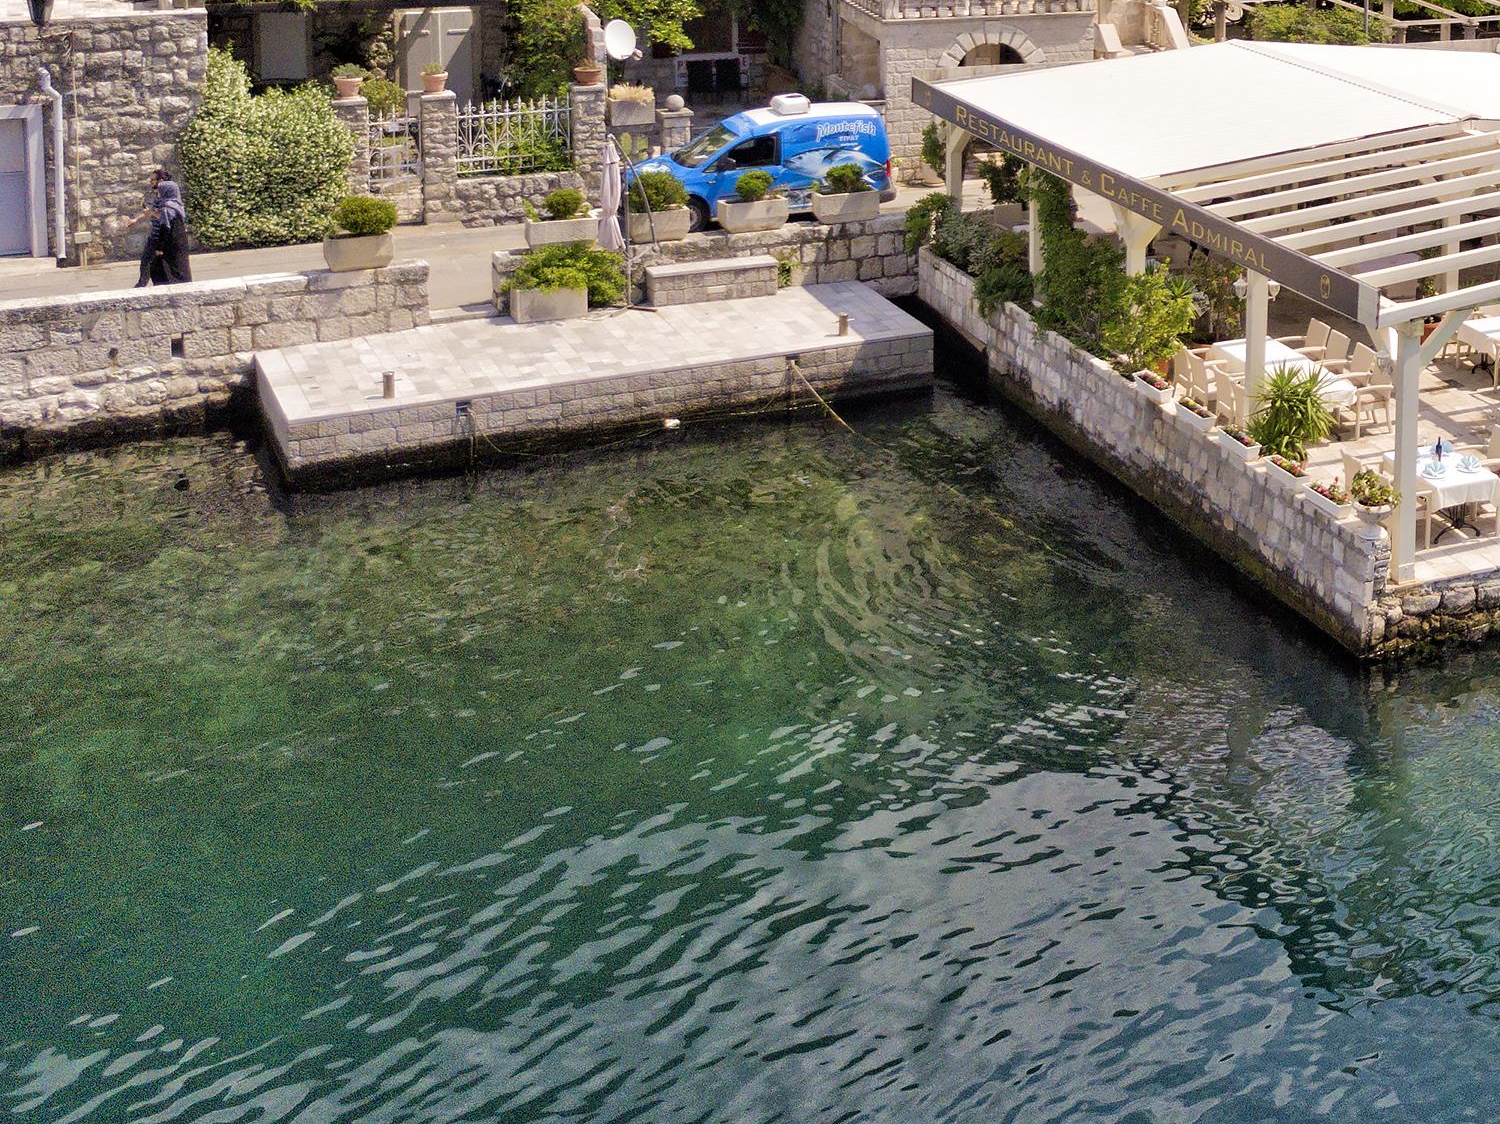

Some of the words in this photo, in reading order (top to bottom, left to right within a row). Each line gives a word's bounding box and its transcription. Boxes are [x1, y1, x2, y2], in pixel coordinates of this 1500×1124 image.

[816, 120, 877, 143] Montefish
[955, 104, 1074, 176] RESTAURANT
[1080, 170, 1093, 187] &
[1100, 173, 1164, 221] CAFFE
[1171, 208, 1272, 273] ADMIRAL
